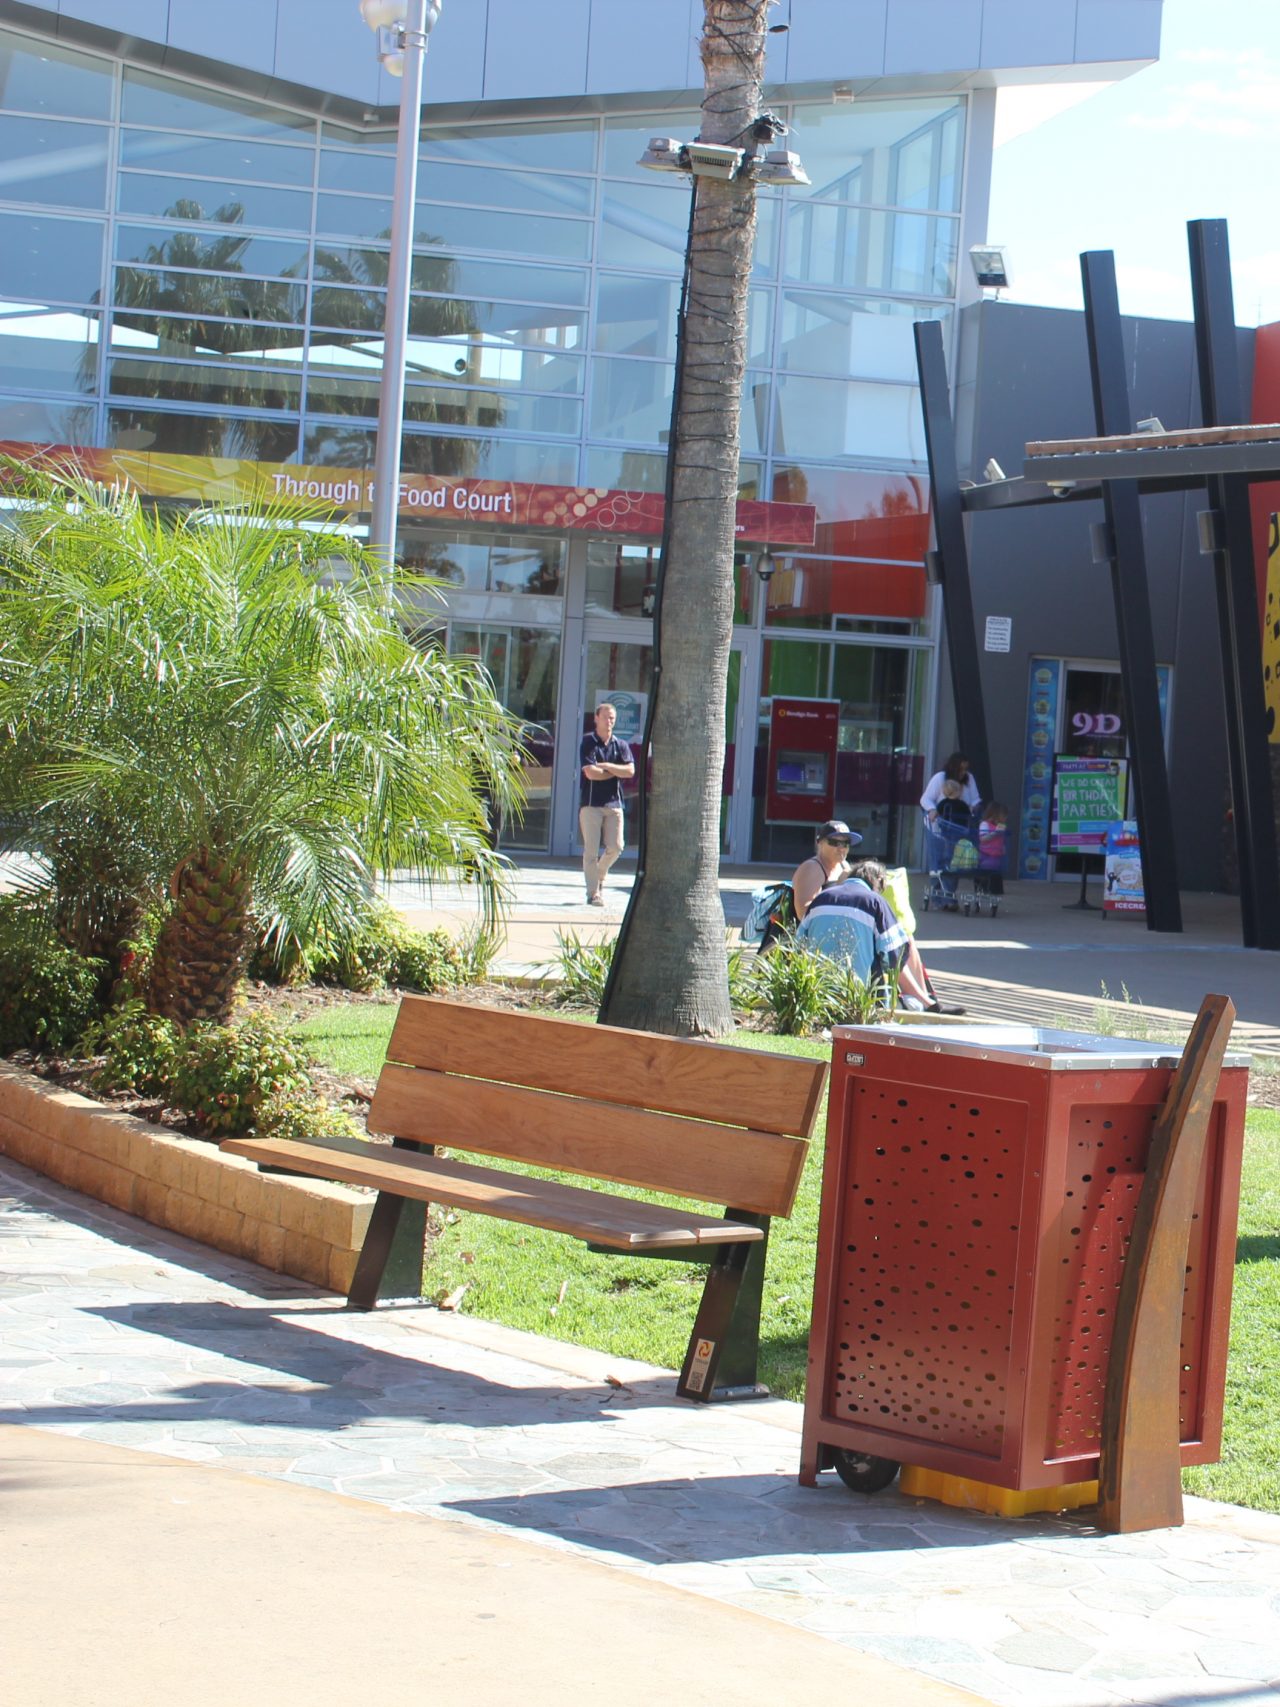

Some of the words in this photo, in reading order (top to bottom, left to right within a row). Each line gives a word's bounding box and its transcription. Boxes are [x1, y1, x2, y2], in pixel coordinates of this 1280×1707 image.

[271, 473, 360, 504] Through
[397, 483, 447, 508] Food
[452, 487, 512, 513] Court
[1072, 712, 1121, 736] 9D
[1063, 789, 1116, 801] BIRTHDAY
